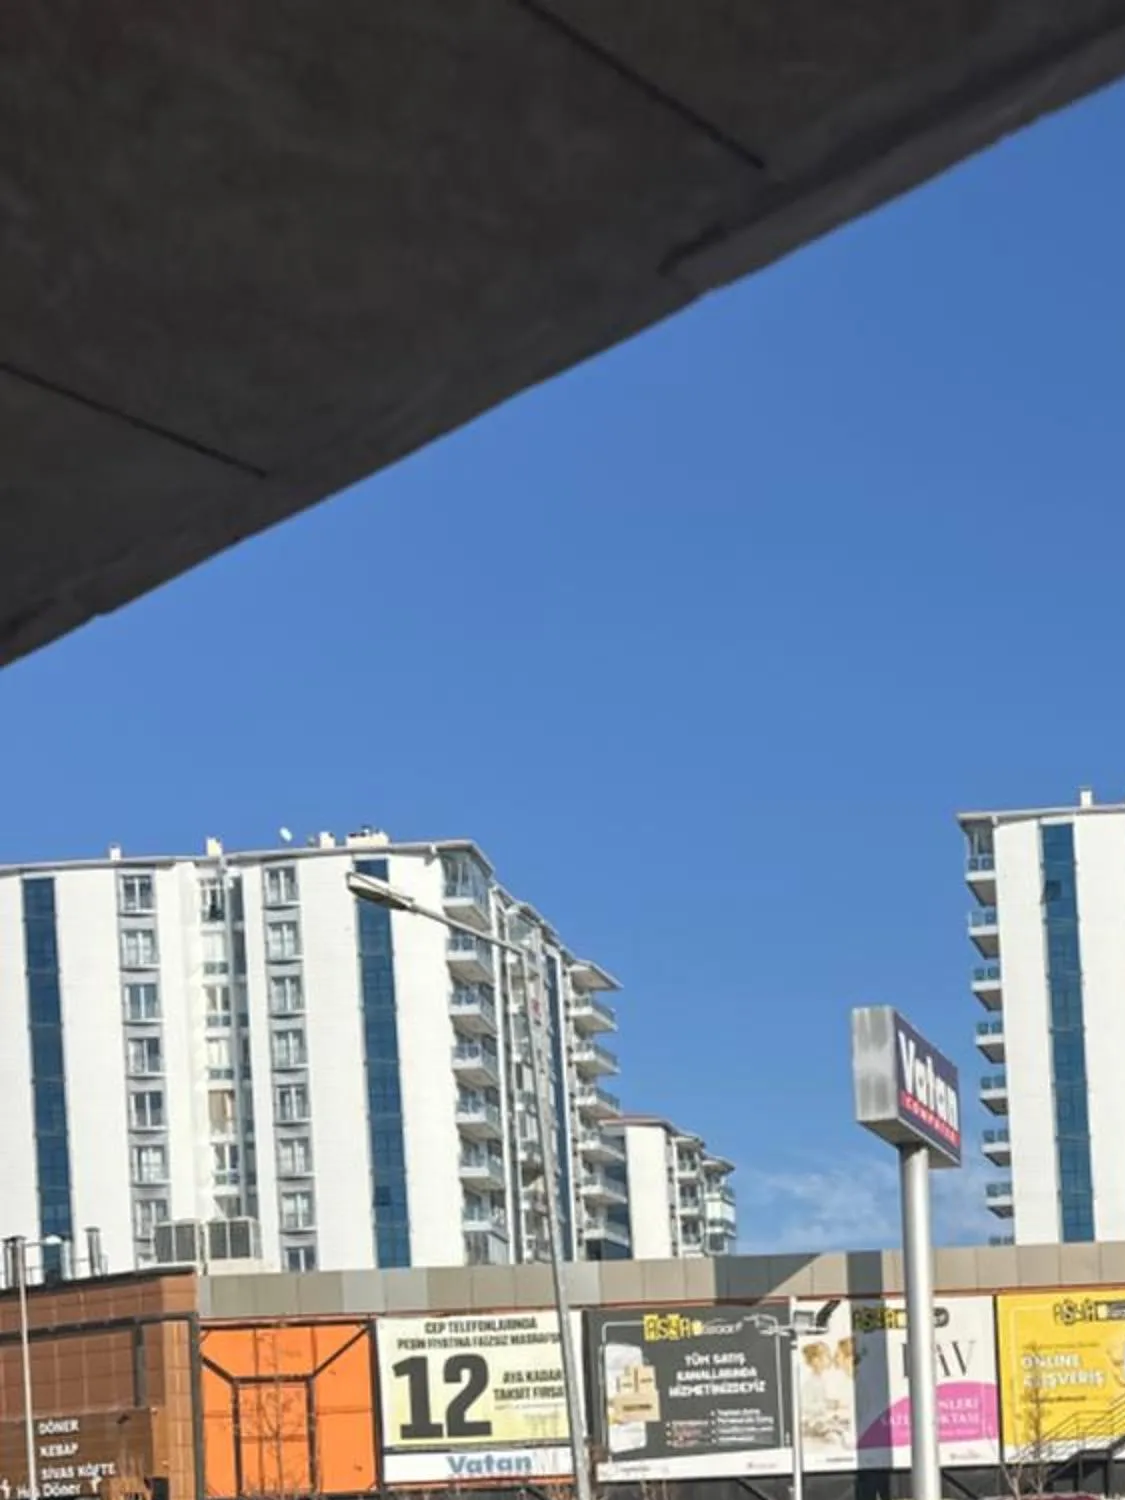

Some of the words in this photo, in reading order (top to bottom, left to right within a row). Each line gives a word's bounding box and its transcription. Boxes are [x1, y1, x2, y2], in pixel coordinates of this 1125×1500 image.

[898, 1030, 959, 1131] Vatan
[424, 1321, 446, 1334] CEP
[391, 1353, 493, 1440] 12
[39, 1419, 79, 1435] DÖNER
[446, 1454, 532, 1473] Vatan
